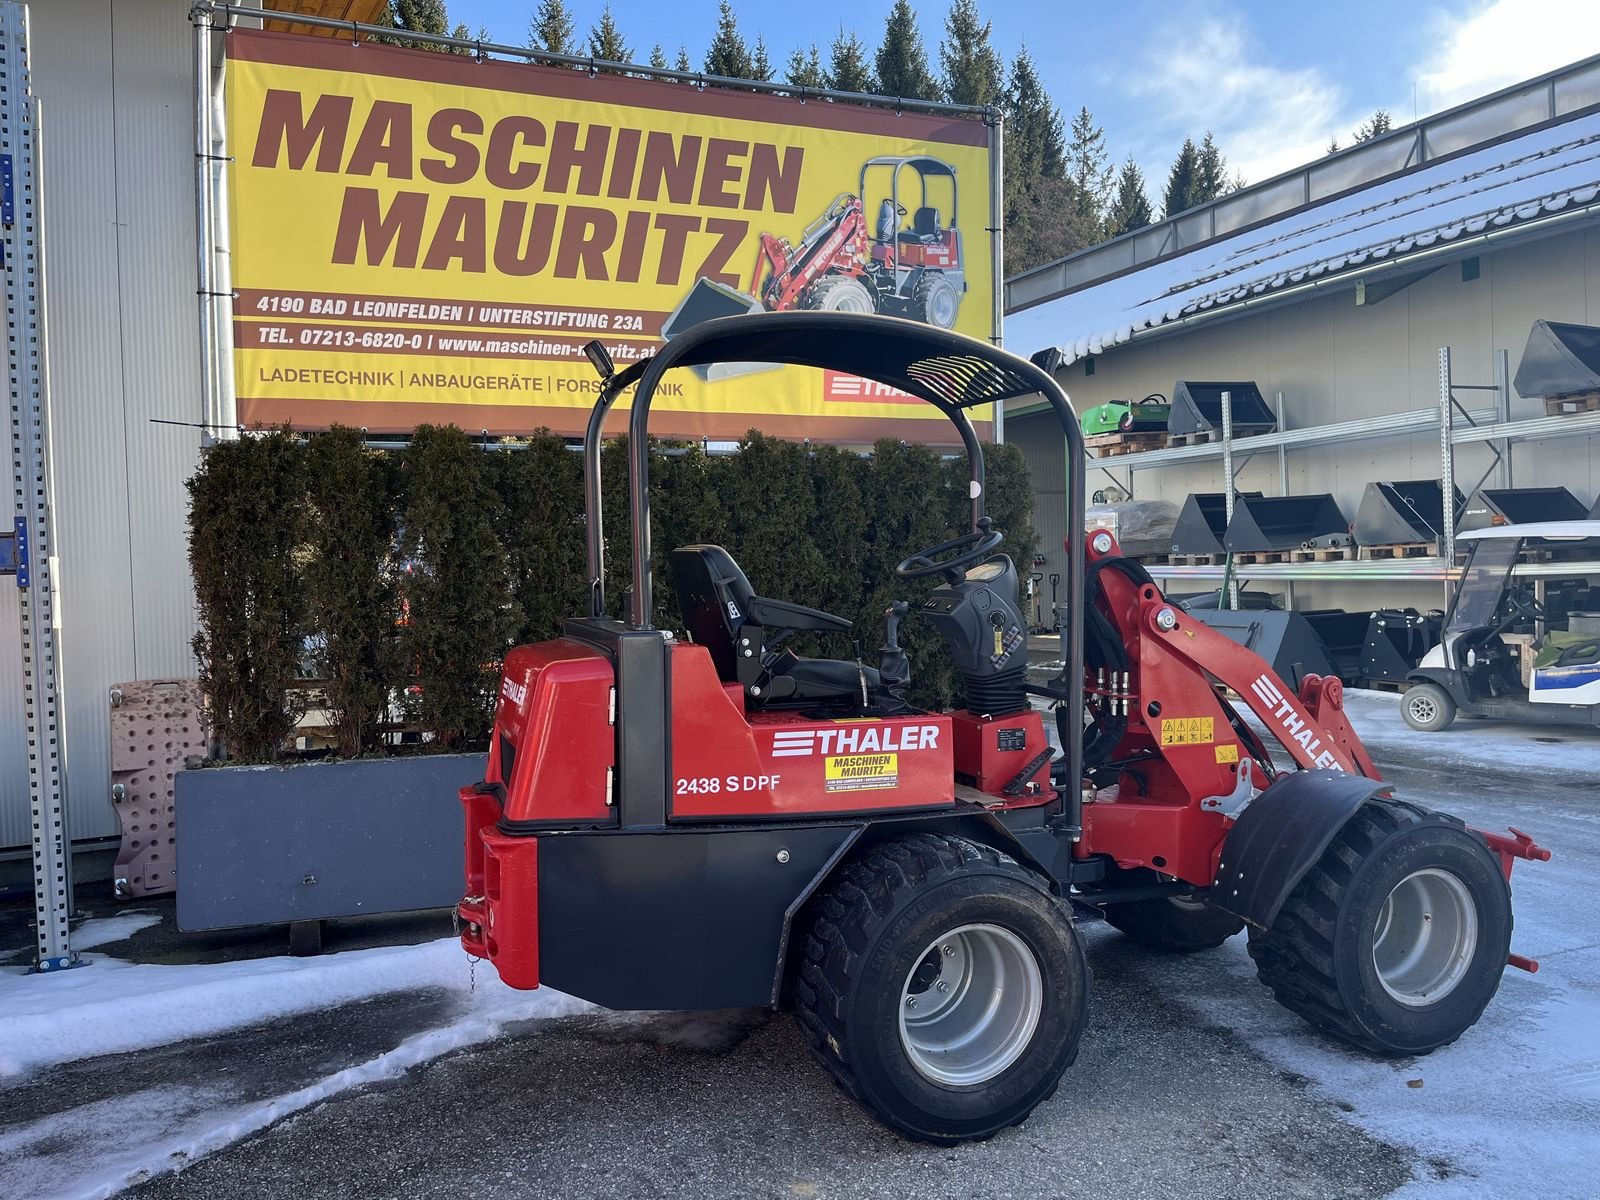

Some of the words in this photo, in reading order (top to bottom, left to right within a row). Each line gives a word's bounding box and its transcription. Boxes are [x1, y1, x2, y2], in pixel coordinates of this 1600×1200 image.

[251, 89, 804, 214] MASCHINEN
[331, 187, 749, 288] MAURITZ
[257, 296, 304, 313] 4190
[309, 298, 347, 315] BAD
[352, 301, 463, 321] LEONFELDEN
[479, 307, 609, 329] UNTERSTIFTUNG
[613, 315, 643, 331] 23A
[259, 327, 294, 344] TEL.
[300, 329, 423, 350] 07213-6820-0
[438, 337, 656, 360] www.maschinen-ritz.at
[259, 368, 395, 386] LADETECHNIK
[409, 373, 543, 391] ANBAUGERÄTE
[556, 379, 684, 397] FORSNIK
[816, 725, 940, 754] THALER
[833, 755, 891, 768] MASCHINEN
[841, 765, 884, 777] MAURITZ
[677, 777, 720, 795] 2438
[725, 775, 740, 792] S
[743, 775, 781, 792] DPF
